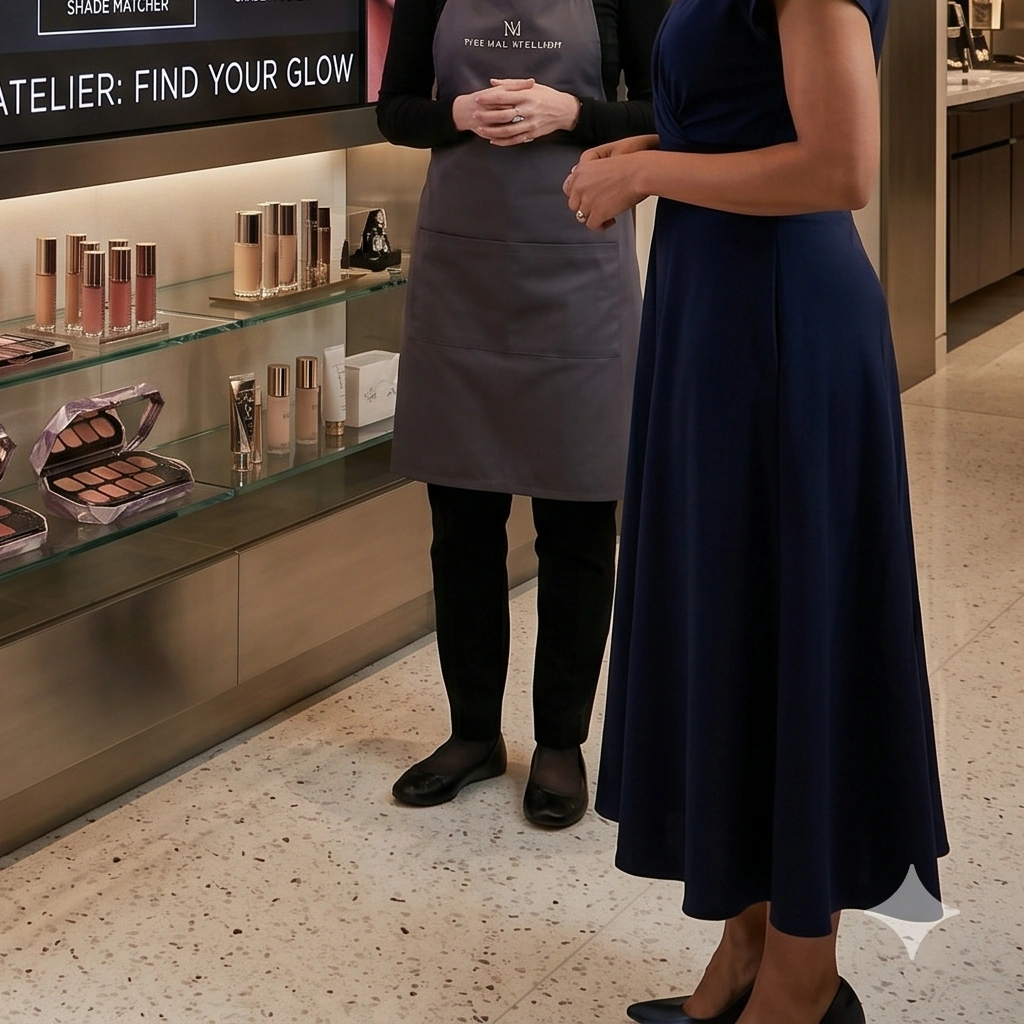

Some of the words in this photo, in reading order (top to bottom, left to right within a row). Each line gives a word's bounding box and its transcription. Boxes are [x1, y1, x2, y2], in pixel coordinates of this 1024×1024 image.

[135, 65, 199, 103] FIND
[208, 59, 278, 95] YOUR
[287, 52, 354, 88] GLOW
